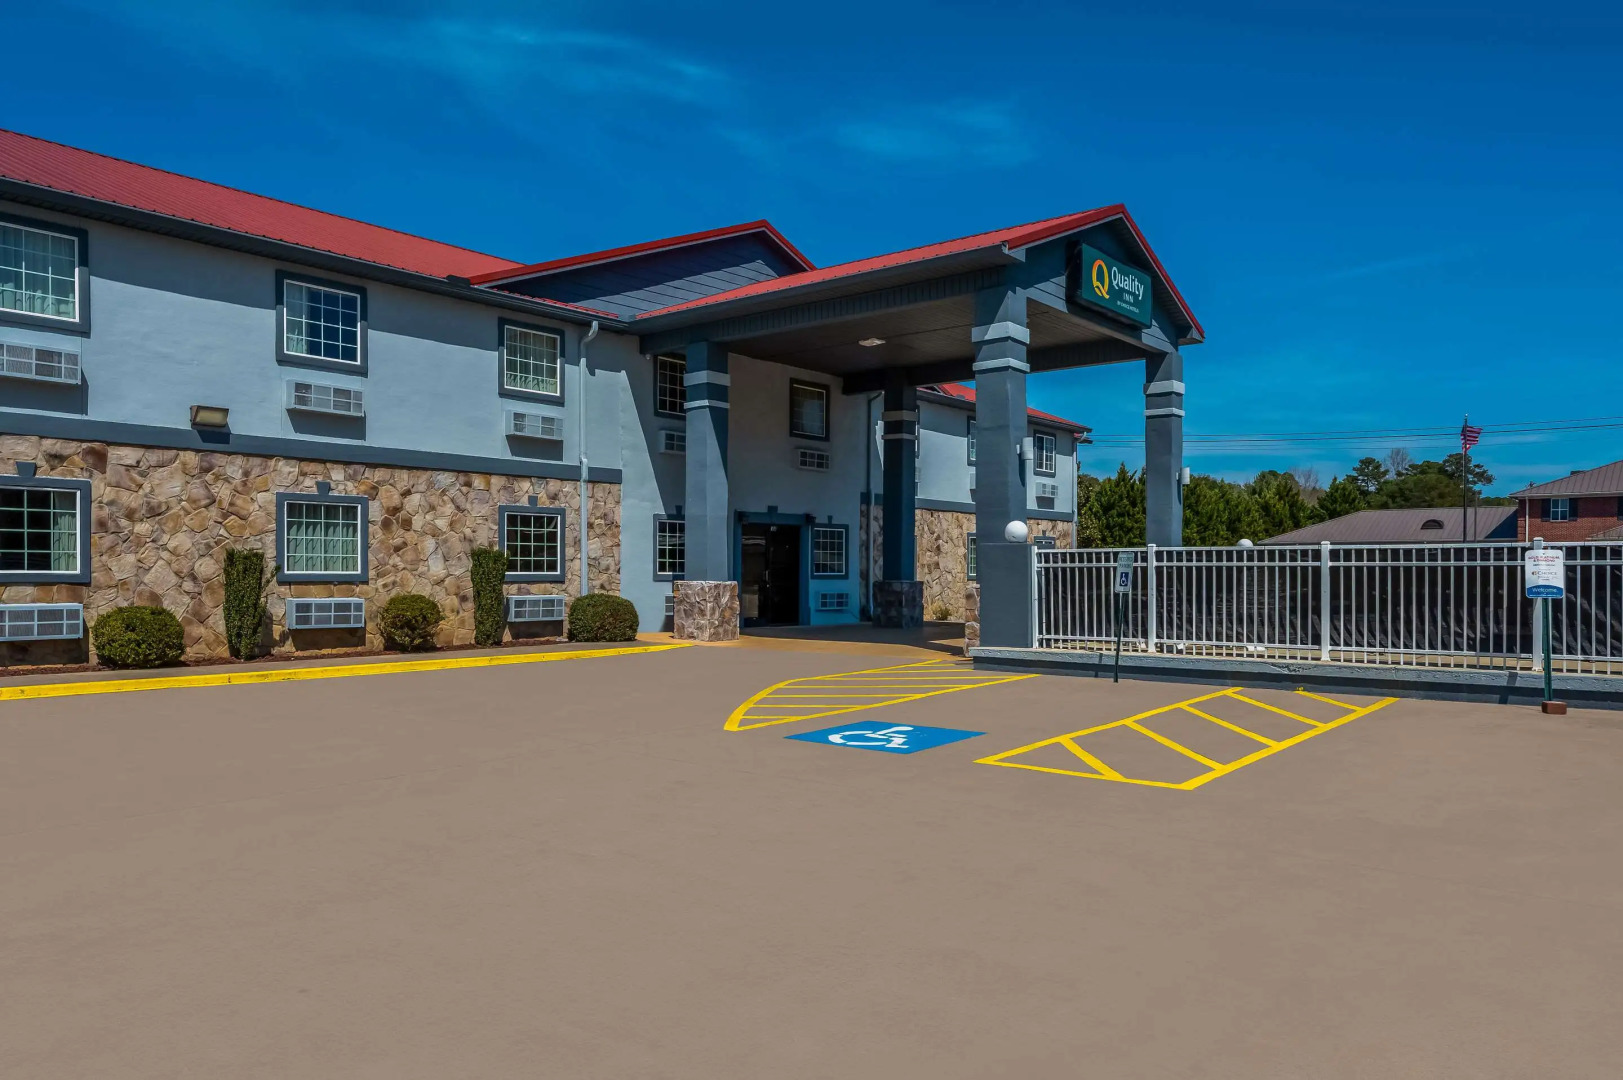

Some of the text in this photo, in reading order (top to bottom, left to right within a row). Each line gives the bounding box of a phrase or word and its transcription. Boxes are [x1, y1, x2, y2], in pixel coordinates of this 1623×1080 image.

[1092, 259, 1109, 299] Q
[1111, 266, 1143, 300] Quality
[1123, 292, 1133, 303] INN
